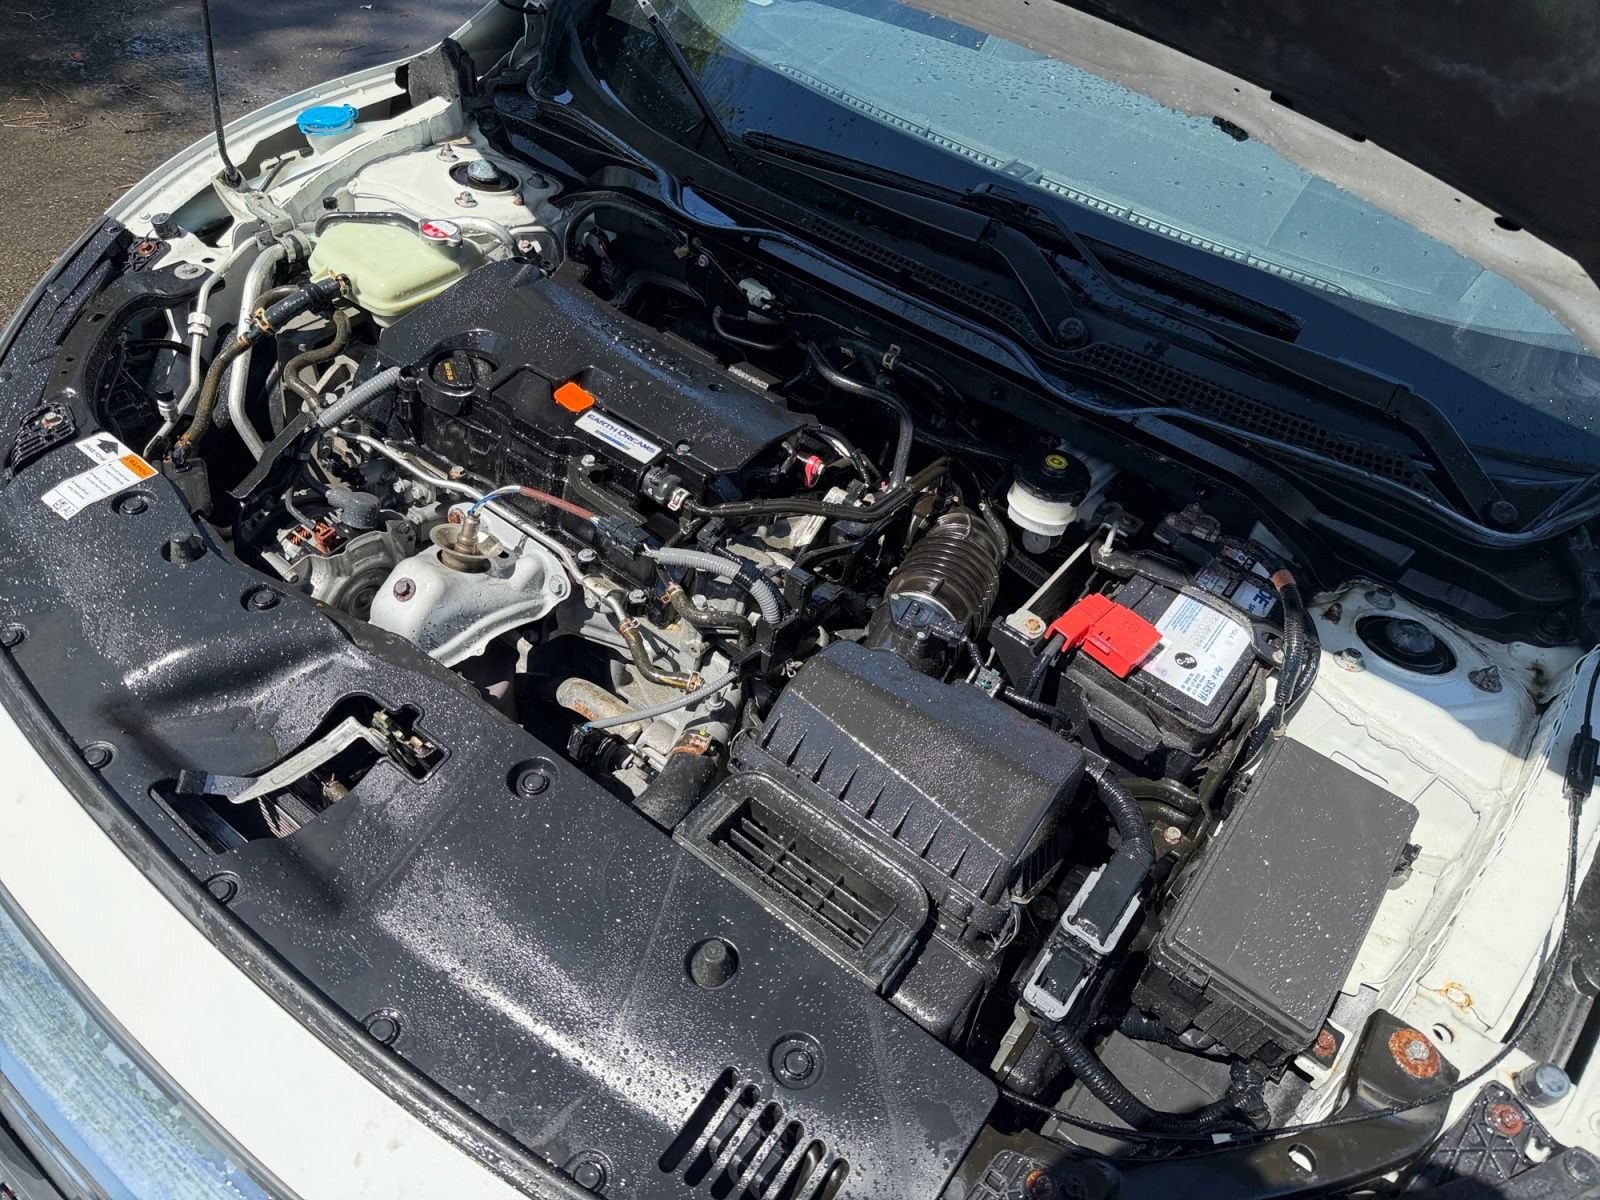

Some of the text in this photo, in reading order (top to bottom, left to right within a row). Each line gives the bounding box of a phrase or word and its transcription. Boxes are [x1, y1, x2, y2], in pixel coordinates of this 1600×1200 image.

[587, 413, 619, 433] EARTH
[618, 430, 657, 454] DREAMS
[1197, 680, 1217, 702] SX51R
